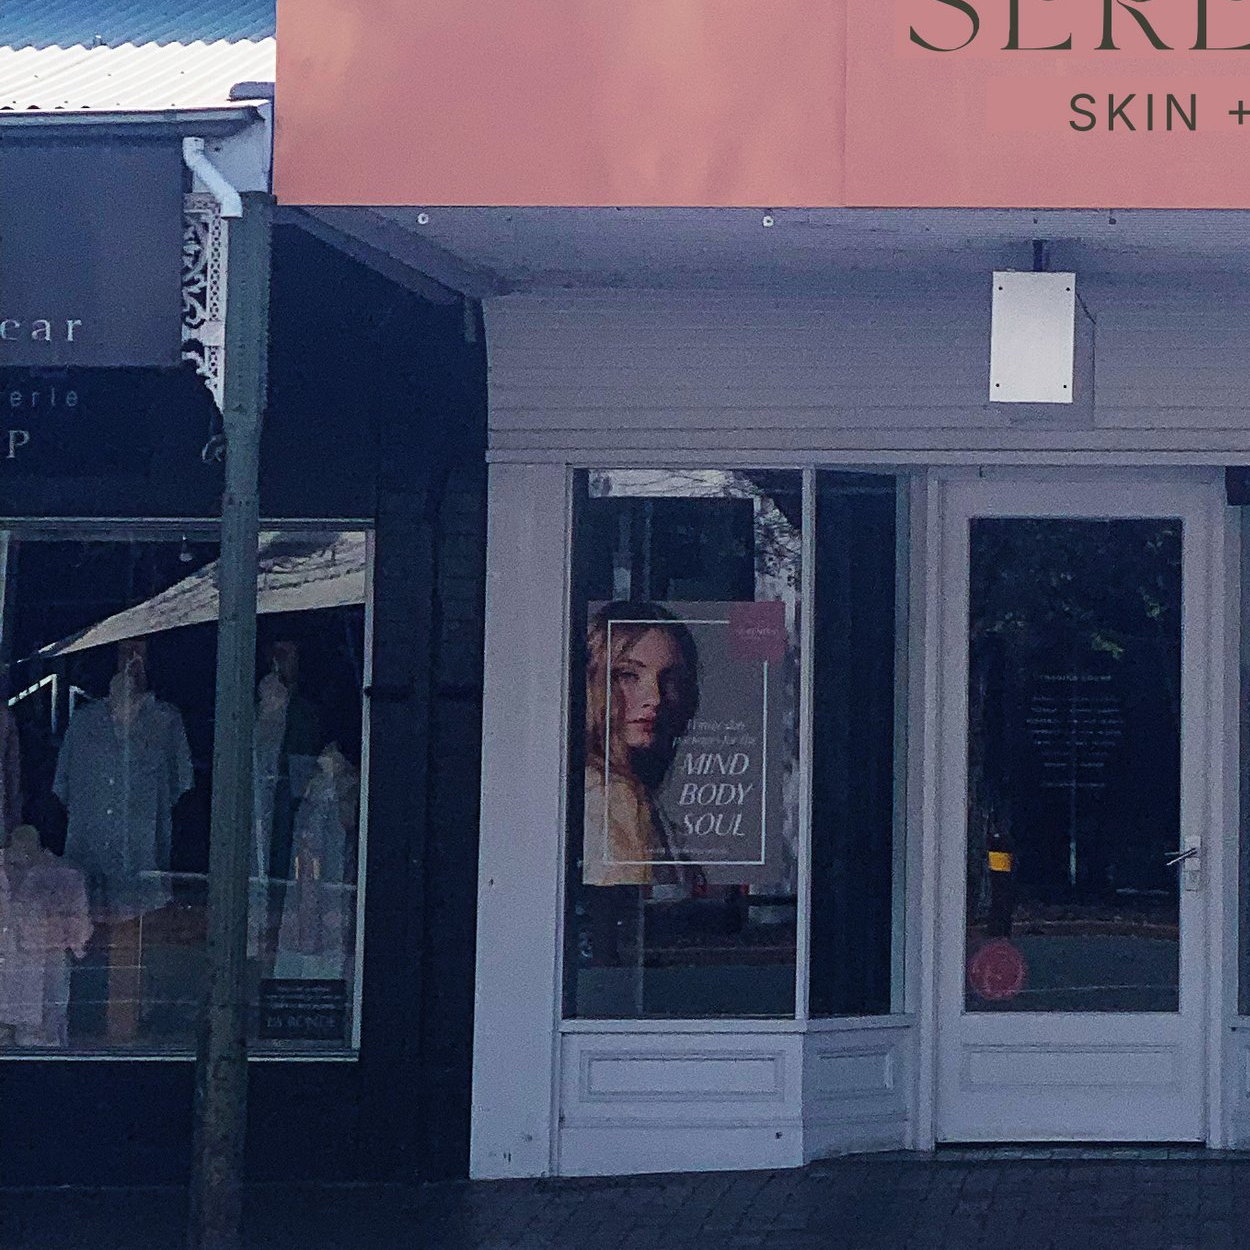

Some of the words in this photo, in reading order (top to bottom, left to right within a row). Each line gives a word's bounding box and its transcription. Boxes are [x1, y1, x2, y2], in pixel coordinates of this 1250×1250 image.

[1069, 93, 1198, 132] SKIN
[684, 753, 749, 774] MIND
[680, 782, 753, 806] BODY
[681, 812, 745, 836] SOUL
